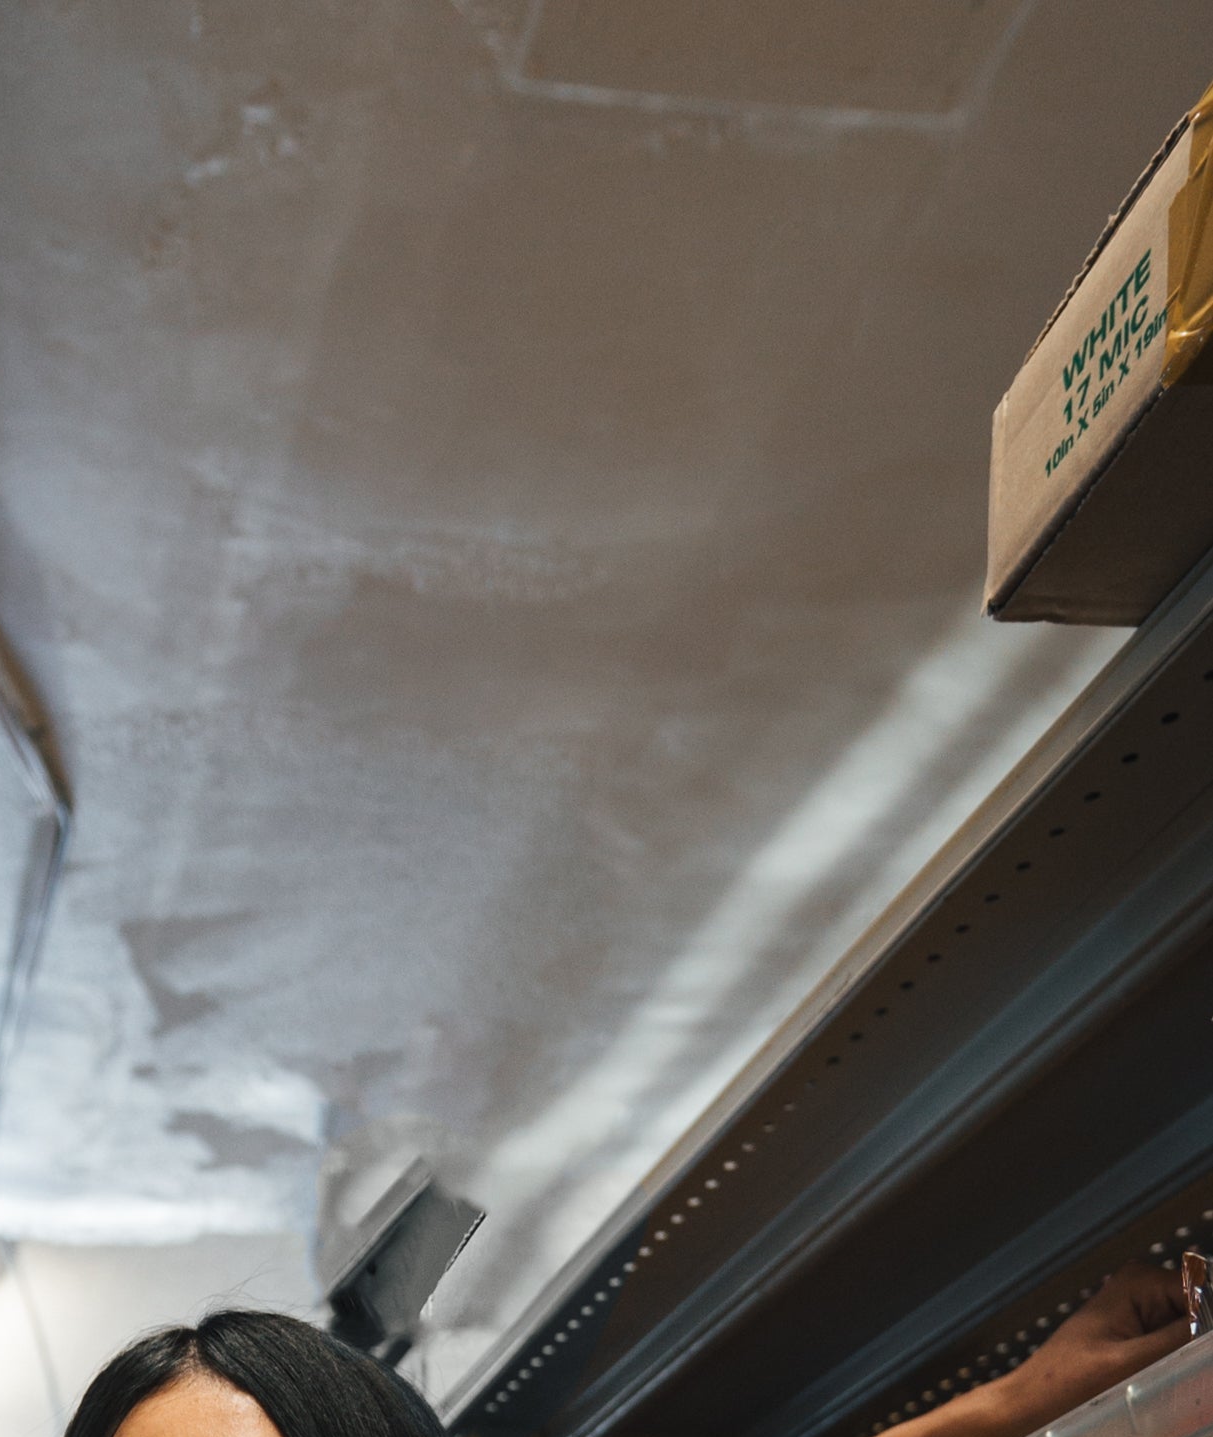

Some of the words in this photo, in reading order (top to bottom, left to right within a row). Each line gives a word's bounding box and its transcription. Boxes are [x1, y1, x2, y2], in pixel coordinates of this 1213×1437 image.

[1045, 432, 1074, 479] 10in
[1092, 380, 1115, 419] 5in
[1134, 307, 1168, 360] 19in
[1062, 248, 1152, 393] WHITE
[1063, 374, 1091, 425] 17
[1098, 294, 1149, 382] MIC
